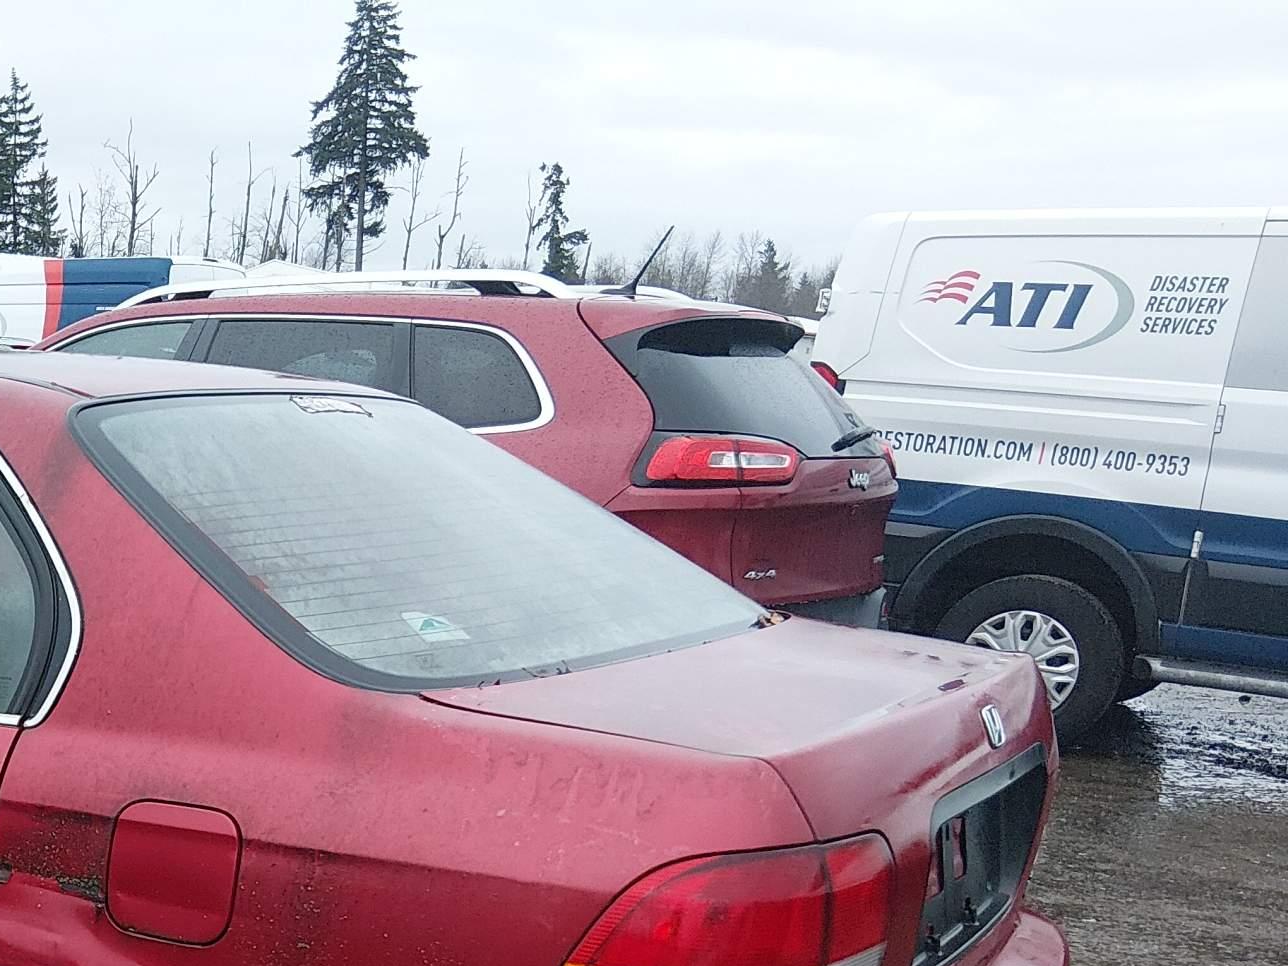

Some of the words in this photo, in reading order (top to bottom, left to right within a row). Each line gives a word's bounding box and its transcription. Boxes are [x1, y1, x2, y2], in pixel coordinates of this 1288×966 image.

[1149, 275, 1230, 294] DISASTER
[954, 281, 1094, 330] ATI
[1144, 295, 1230, 315] RECOVERY
[1140, 316, 1218, 336] SERVICES
[1050, 442, 1099, 470] (800)
[1102, 449, 1191, 477] 400-9353
